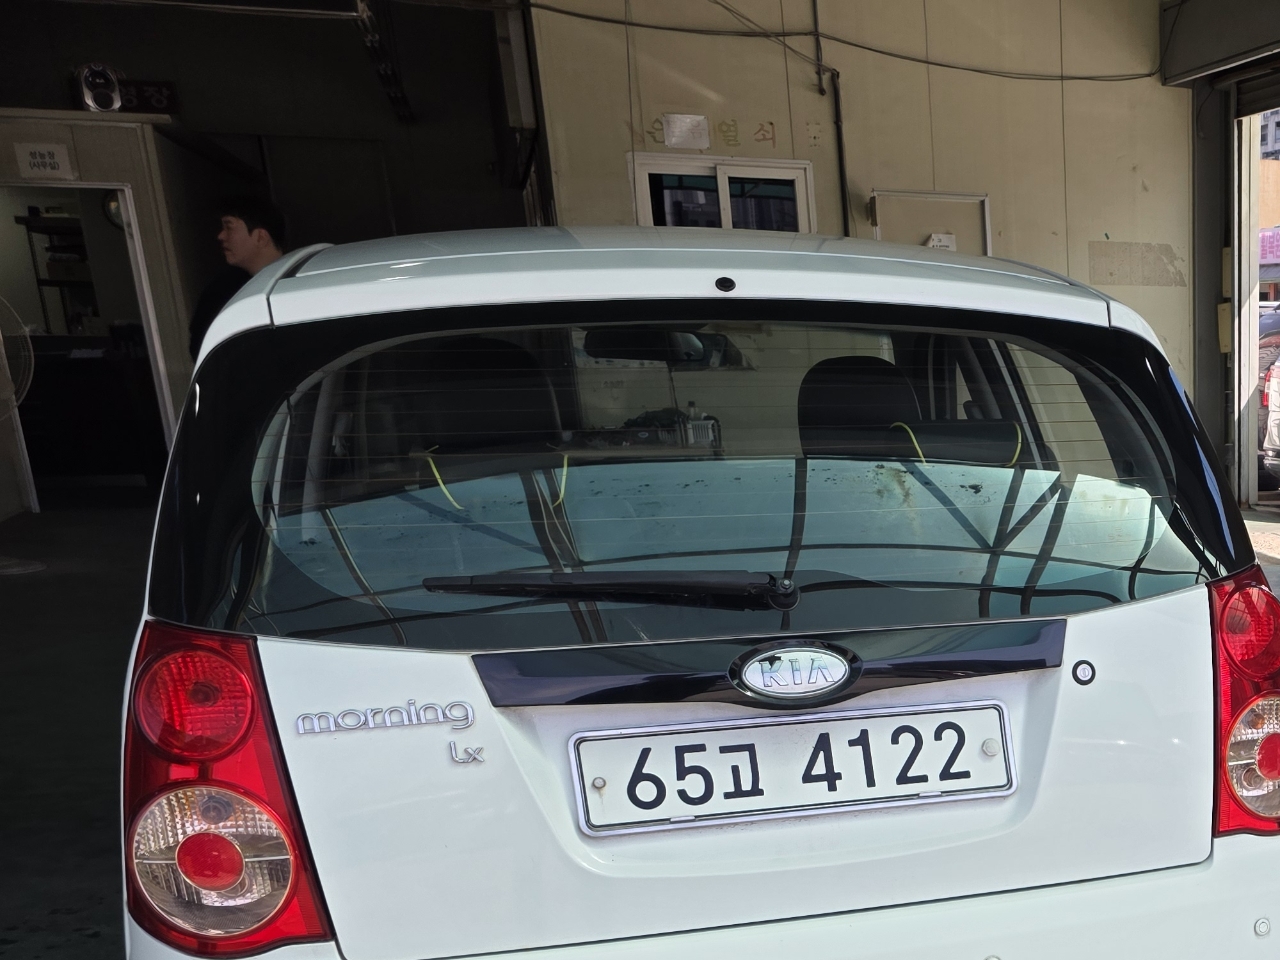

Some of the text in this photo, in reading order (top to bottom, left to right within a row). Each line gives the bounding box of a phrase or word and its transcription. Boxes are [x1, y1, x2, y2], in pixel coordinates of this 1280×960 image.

[758, 657, 836, 687] KIA
[297, 699, 475, 734] morning
[801, 721, 972, 792] 4122
